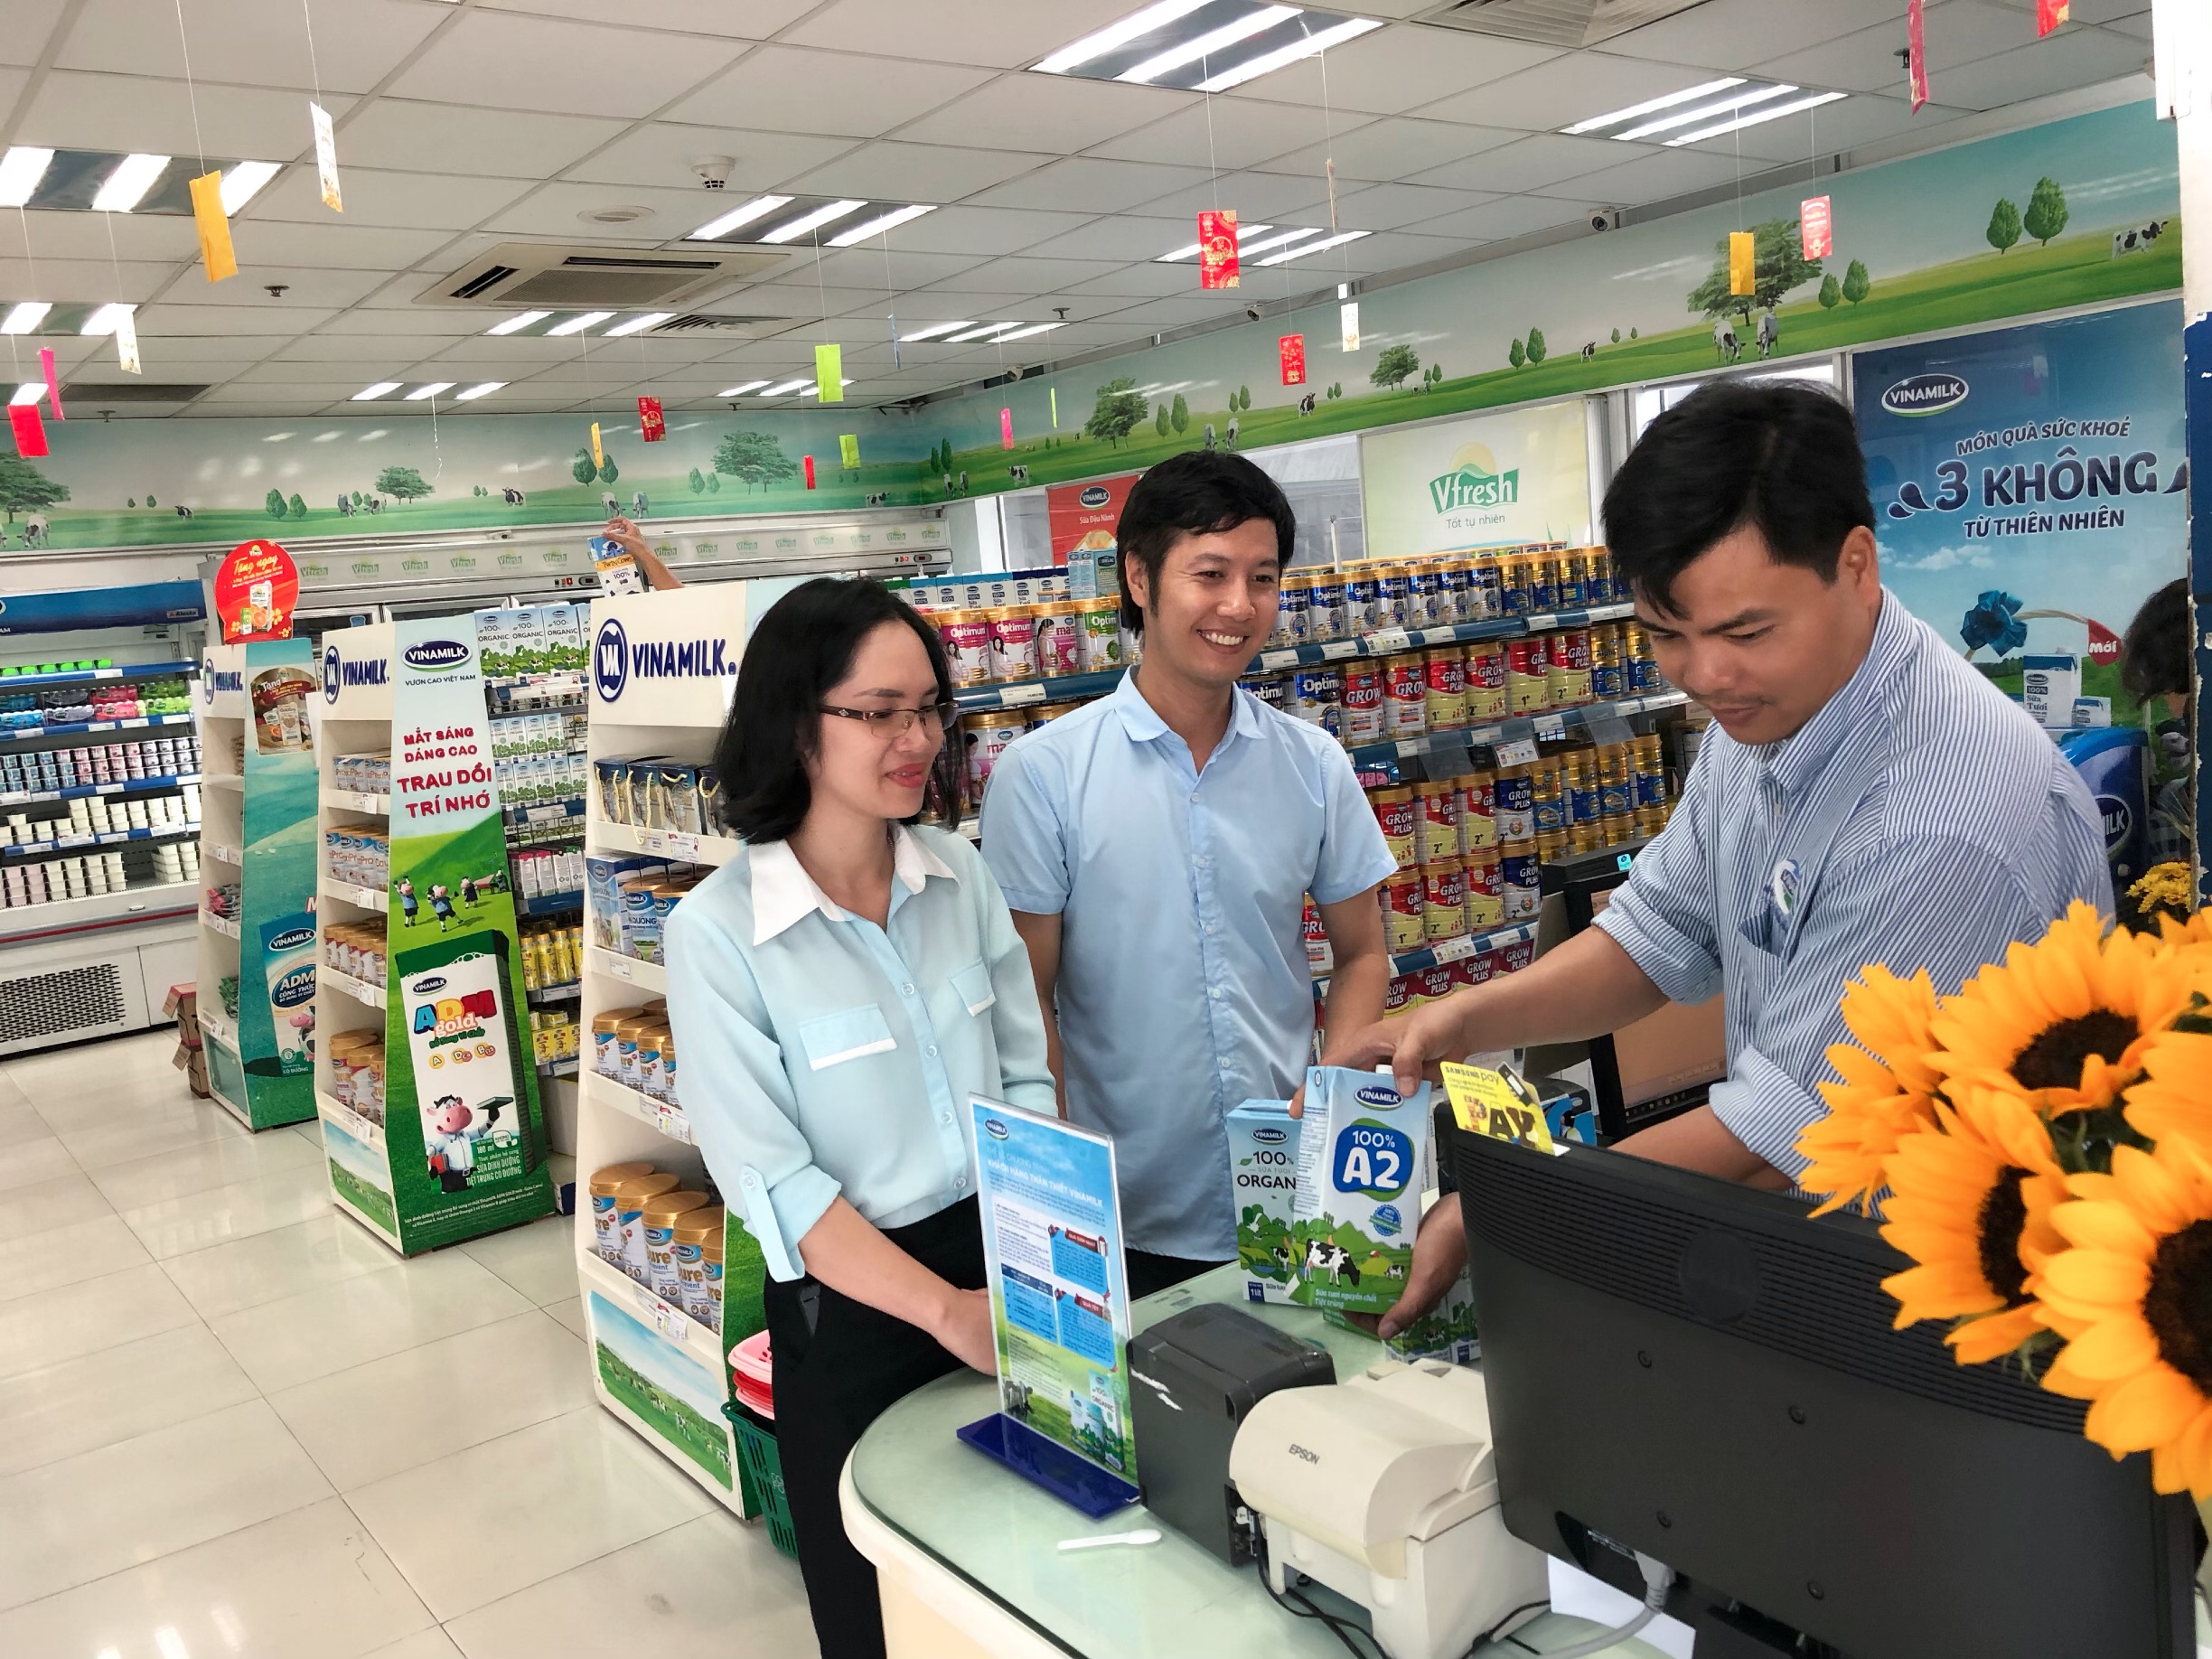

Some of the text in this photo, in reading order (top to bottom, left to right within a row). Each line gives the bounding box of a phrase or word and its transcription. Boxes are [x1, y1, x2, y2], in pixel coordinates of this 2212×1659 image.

[1889, 381, 1960, 405] VINAMILK
[1957, 428, 1998, 456] MÓN
[2001, 426, 2039, 448] QUÀ
[2040, 416, 2076, 440] SỨC
[1935, 445, 2158, 512] 3 KHÔNG
[1081, 491, 1109, 505] VINAMILK
[1433, 470, 1514, 512] Vfresh
[1446, 515, 1462, 529] Tốt
[1478, 513, 1505, 526] nhiên
[1964, 504, 2125, 539] TỪ THIÊN NHIÊN
[547, 627, 578, 636] ORGANIC
[408, 646, 466, 661] VINAMILK
[405, 678, 426, 687] VƯƠN
[443, 674, 458, 684] VIỆT
[1345, 687, 1382, 704] GROW
[403, 726, 432, 745] MẮT
[436, 726, 474, 740] SÁNG
[404, 745, 478, 763] DÁNG CAO
[397, 769, 453, 794] TRAU
[405, 789, 491, 819] TRÍ NHỚ
[273, 931, 313, 948] VINAMILK
[1505, 945, 1531, 962] GROW
[1467, 958, 1493, 975] GROW
[1512, 957, 1528, 970] PLUS
[280, 969, 315, 991] ADM
[1425, 970, 1452, 987] GROW
[1472, 970, 1490, 983] PLUS
[415, 979, 445, 992] VINAMILK
[1430, 981, 1448, 995] PLUS
[1386, 993, 1405, 1007] PLUS
[414, 989, 497, 1035] ADM
[434, 1010, 478, 1038] gold
[1445, 1065, 1480, 1079] SAMSUNG
[1480, 1073, 1500, 1086] pay
[1359, 1091, 1400, 1104] VINAMILK
[1254, 1130, 1284, 1139] VINAMILK
[1352, 1130, 1396, 1148] 100%
[1252, 1150, 1294, 1166] 100%
[1343, 1146, 1401, 1189] A2
[1289, 1443, 1320, 1465] EPSON
